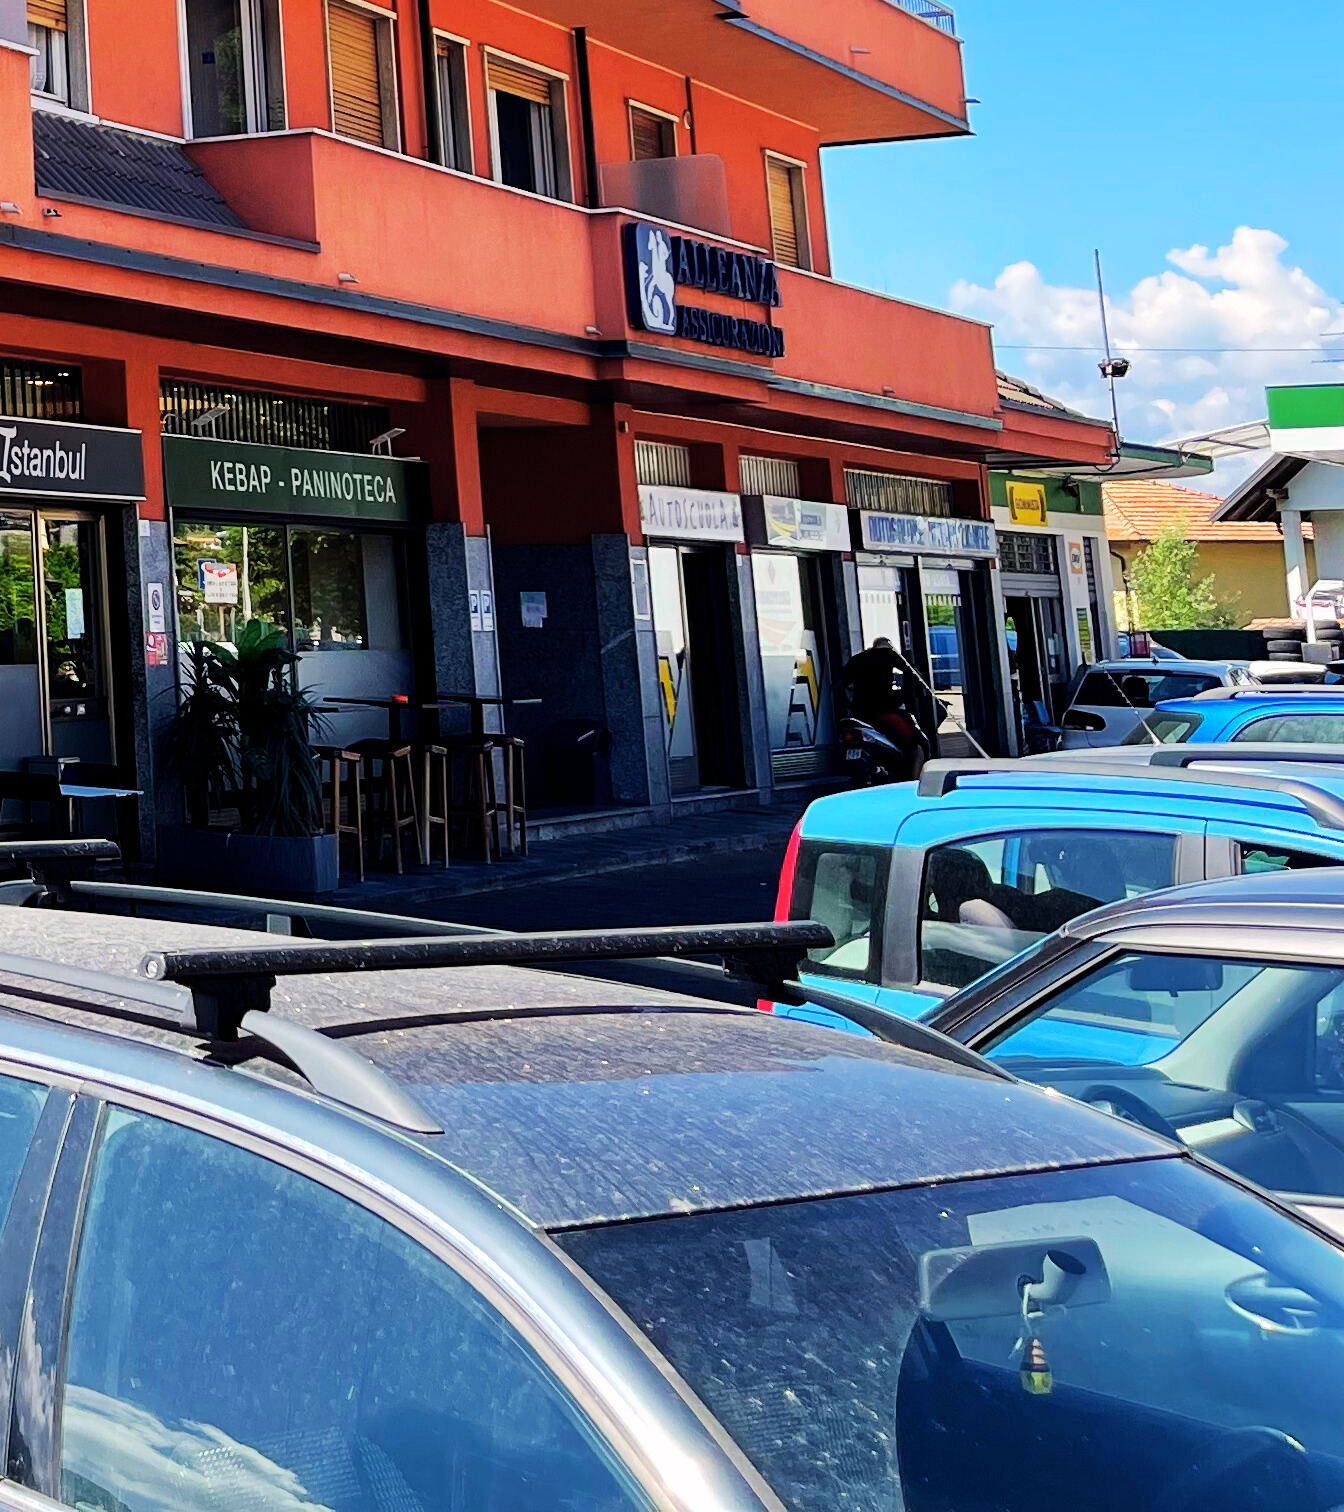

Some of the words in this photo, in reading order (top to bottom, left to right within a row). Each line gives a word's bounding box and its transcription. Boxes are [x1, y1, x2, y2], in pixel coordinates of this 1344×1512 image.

[672, 237, 781, 308] ALLEANZA
[211, 459, 271, 494] KEBAP
[290, 467, 397, 504] PANINOTECA
[649, 492, 729, 530] AUTOSCUOLA
